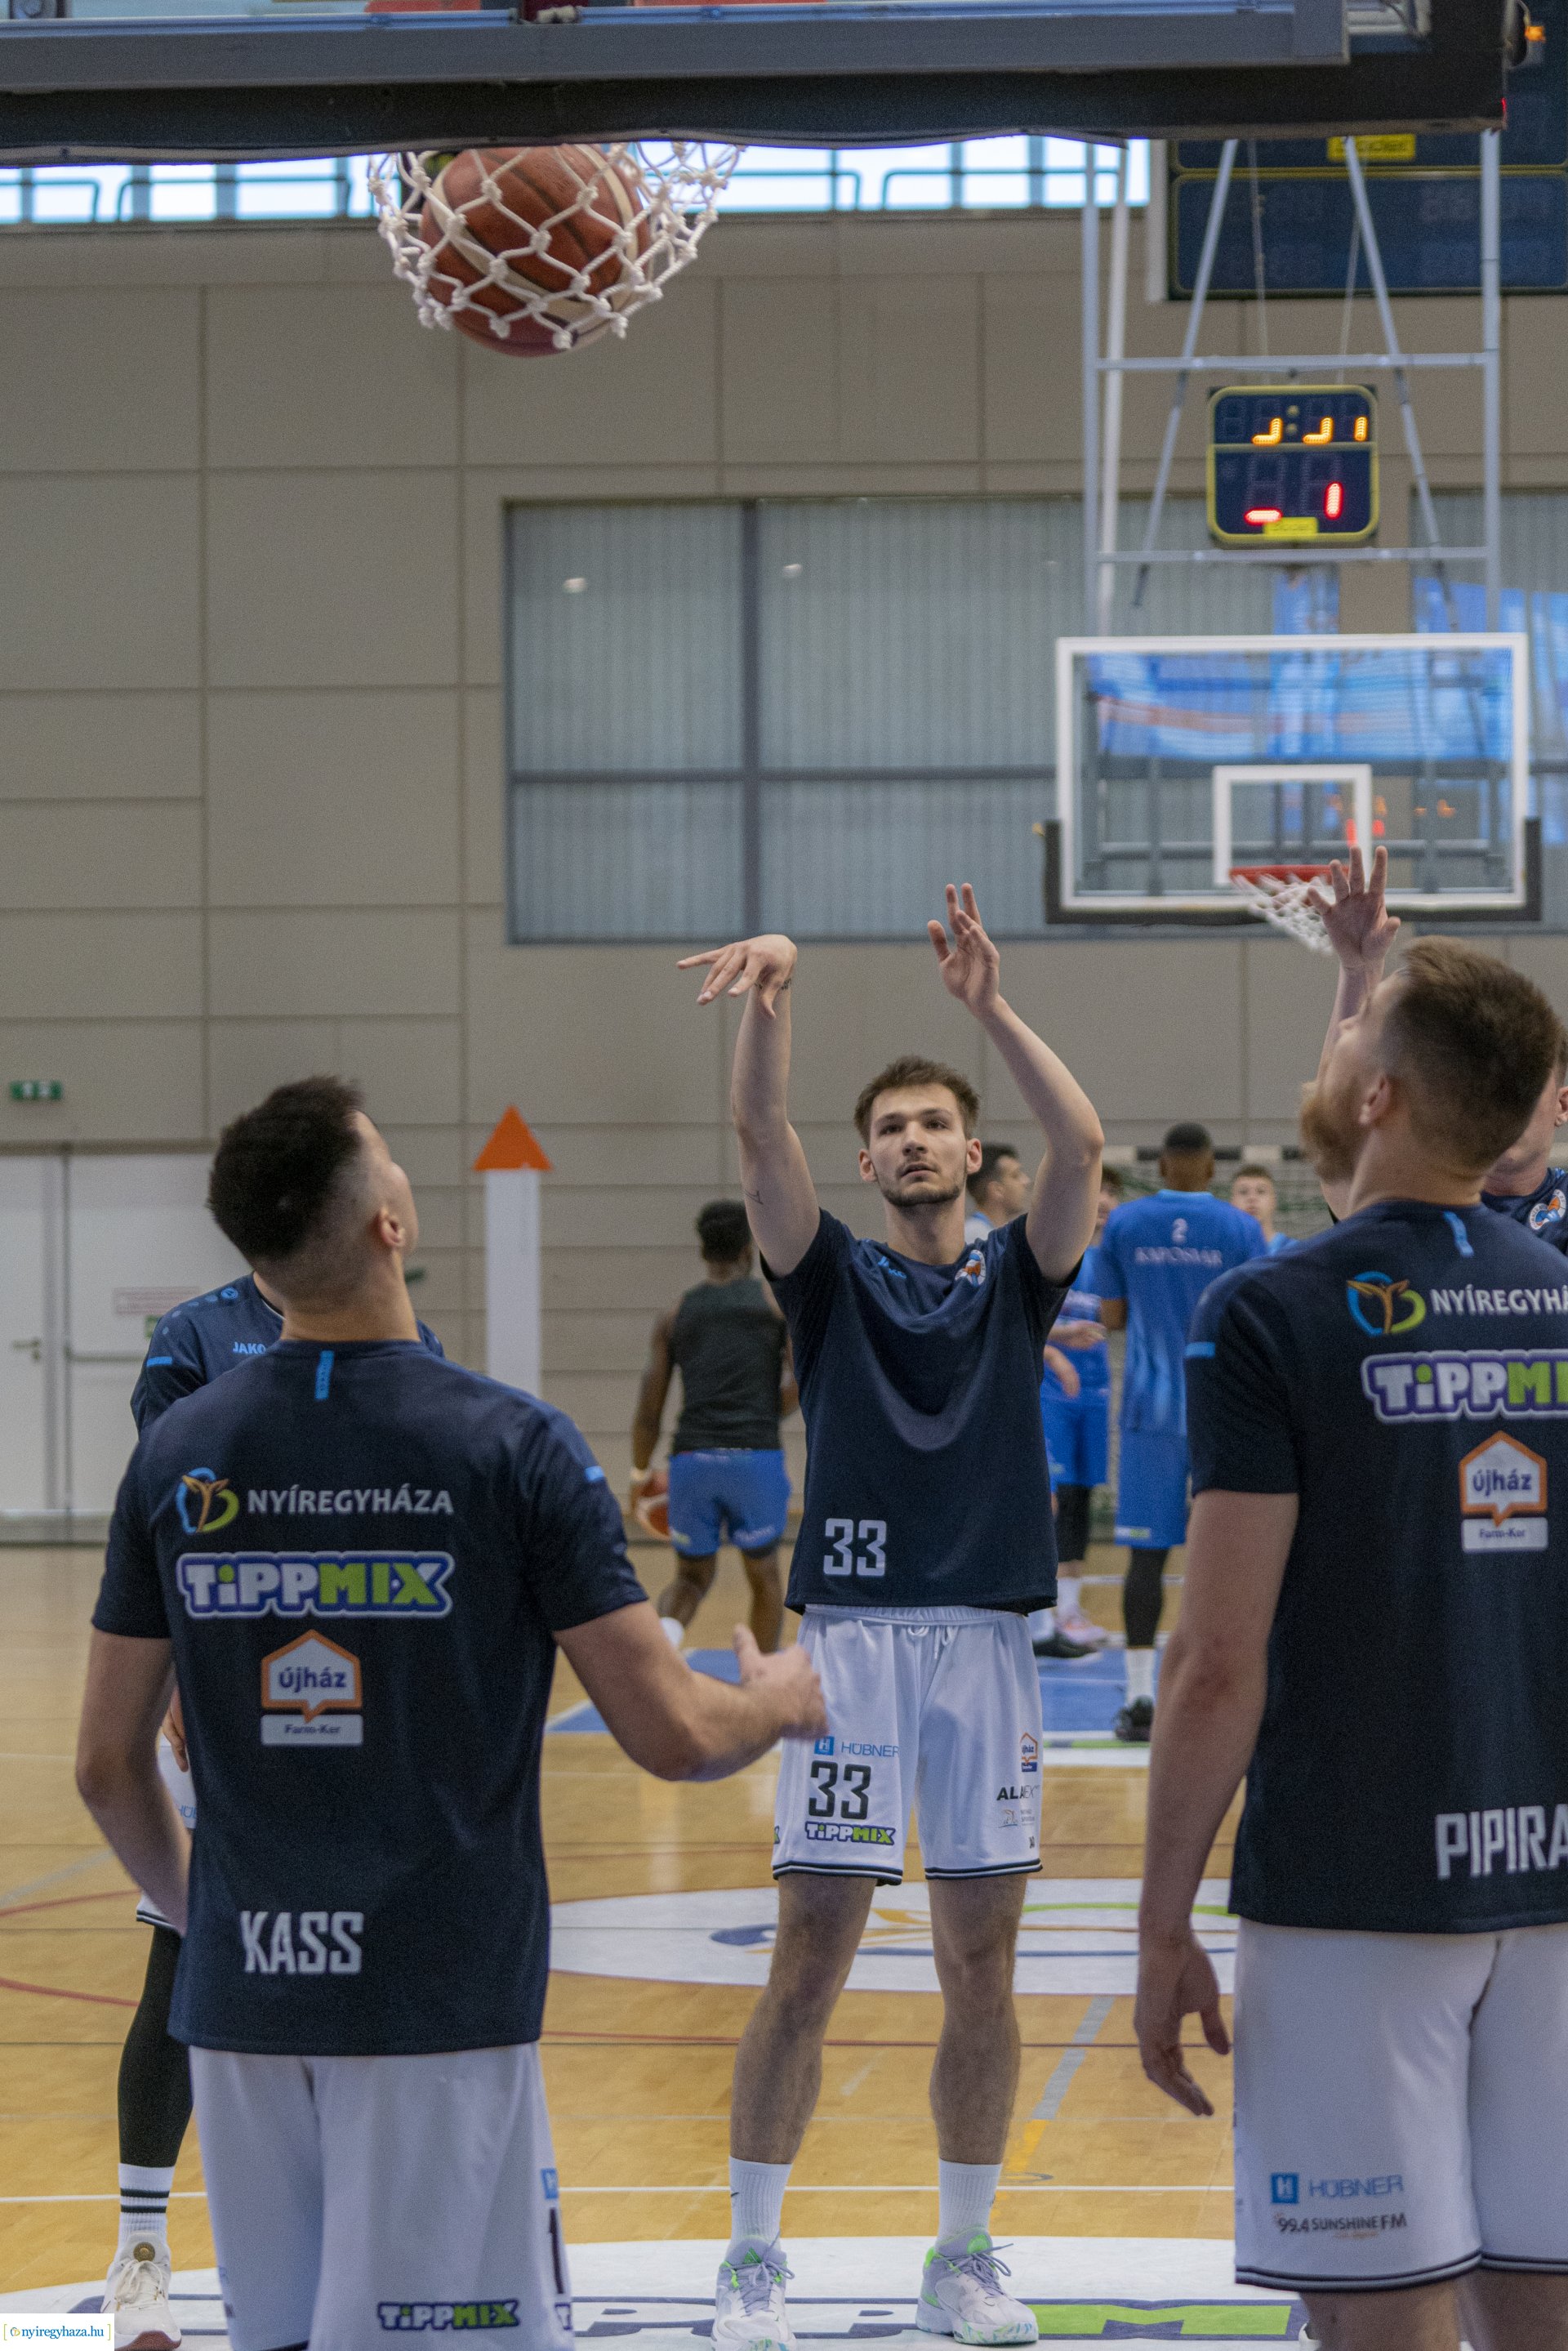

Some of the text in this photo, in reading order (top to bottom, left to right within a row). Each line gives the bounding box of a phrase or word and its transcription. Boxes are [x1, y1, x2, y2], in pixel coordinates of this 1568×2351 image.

[232, 1341, 266, 1354] JAKO
[247, 1483, 453, 1514] NYÍREGYHÁZA
[1472, 1469, 1531, 1497] újház
[823, 1518, 887, 1577] 33
[278, 1666, 346, 1693] újház
[808, 1760, 871, 1820] 33
[1435, 1804, 1568, 1880] PIPIRA
[241, 1910, 365, 1974] KASS
